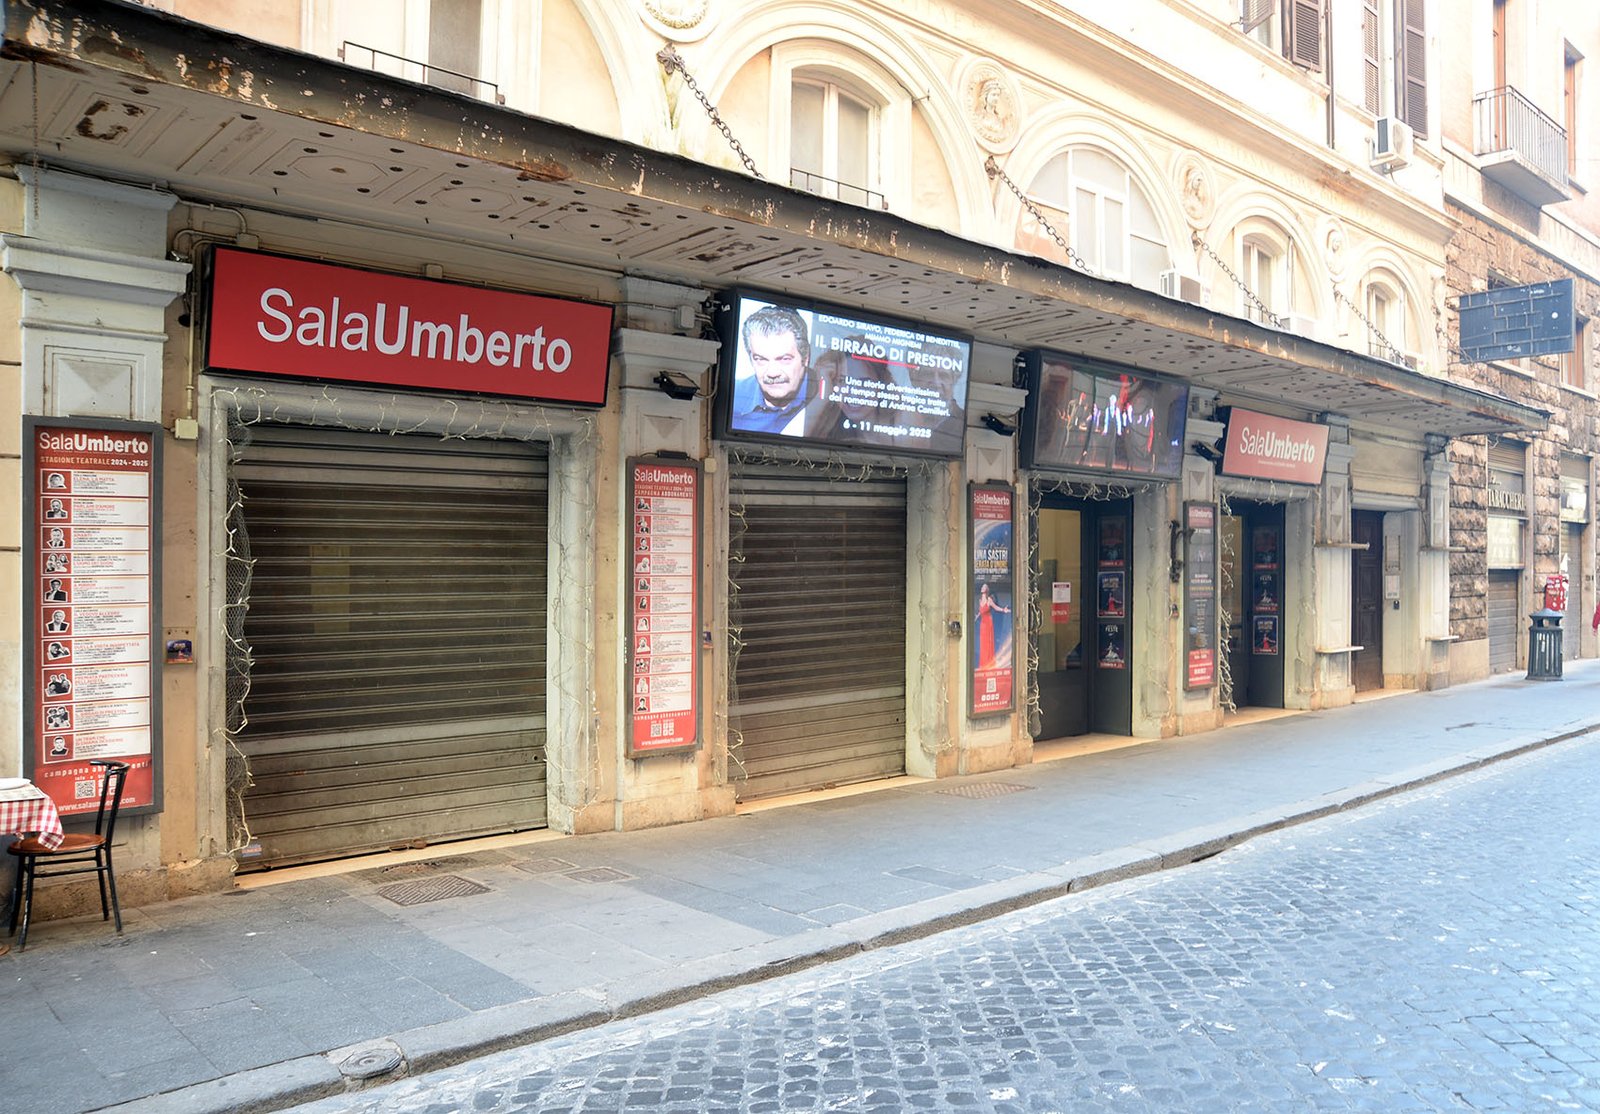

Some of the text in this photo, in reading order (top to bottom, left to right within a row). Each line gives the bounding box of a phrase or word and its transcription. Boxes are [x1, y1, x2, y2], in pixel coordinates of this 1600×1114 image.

[257, 287, 572, 373] SalaUmberto
[818, 314, 854, 328] EDOARDO
[856, 321, 883, 334] SIRAVO,
[884, 326, 915, 340] FEDERICA
[916, 333, 925, 342] DE
[865, 333, 922, 350] MIMMO MIGNEMI
[815, 334, 963, 372] IL BIRRAIO DI PRESTON
[841, 386, 849, 394] al
[850, 387, 876, 399] tempo
[877, 390, 900, 401] stesso
[927, 397, 946, 408] tratta
[845, 376, 940, 398] Una storia divertentissima
[828, 393, 951, 417] dal romanzo di Andrea Camilleri.
[842, 419, 850, 429] 6
[859, 420, 871, 431] 11
[873, 424, 908, 438] maggio
[909, 426, 932, 438] 2025
[39, 432, 149, 454] SalaUmberto
[1239, 426, 1316, 464] SalaUmberto
[40, 456, 75, 464] STAGIONE
[76, 457, 110, 465] TEATRALE
[634, 468, 693, 485] SalaUmberto
[974, 493, 1010, 506] SalaUmberto
[1488, 488, 1526, 512] TABACCHERI
[44, 766, 89, 778] campagna
[91, 761, 149, 773] abbenti
[58, 797, 136, 812] www.salaumer.com
